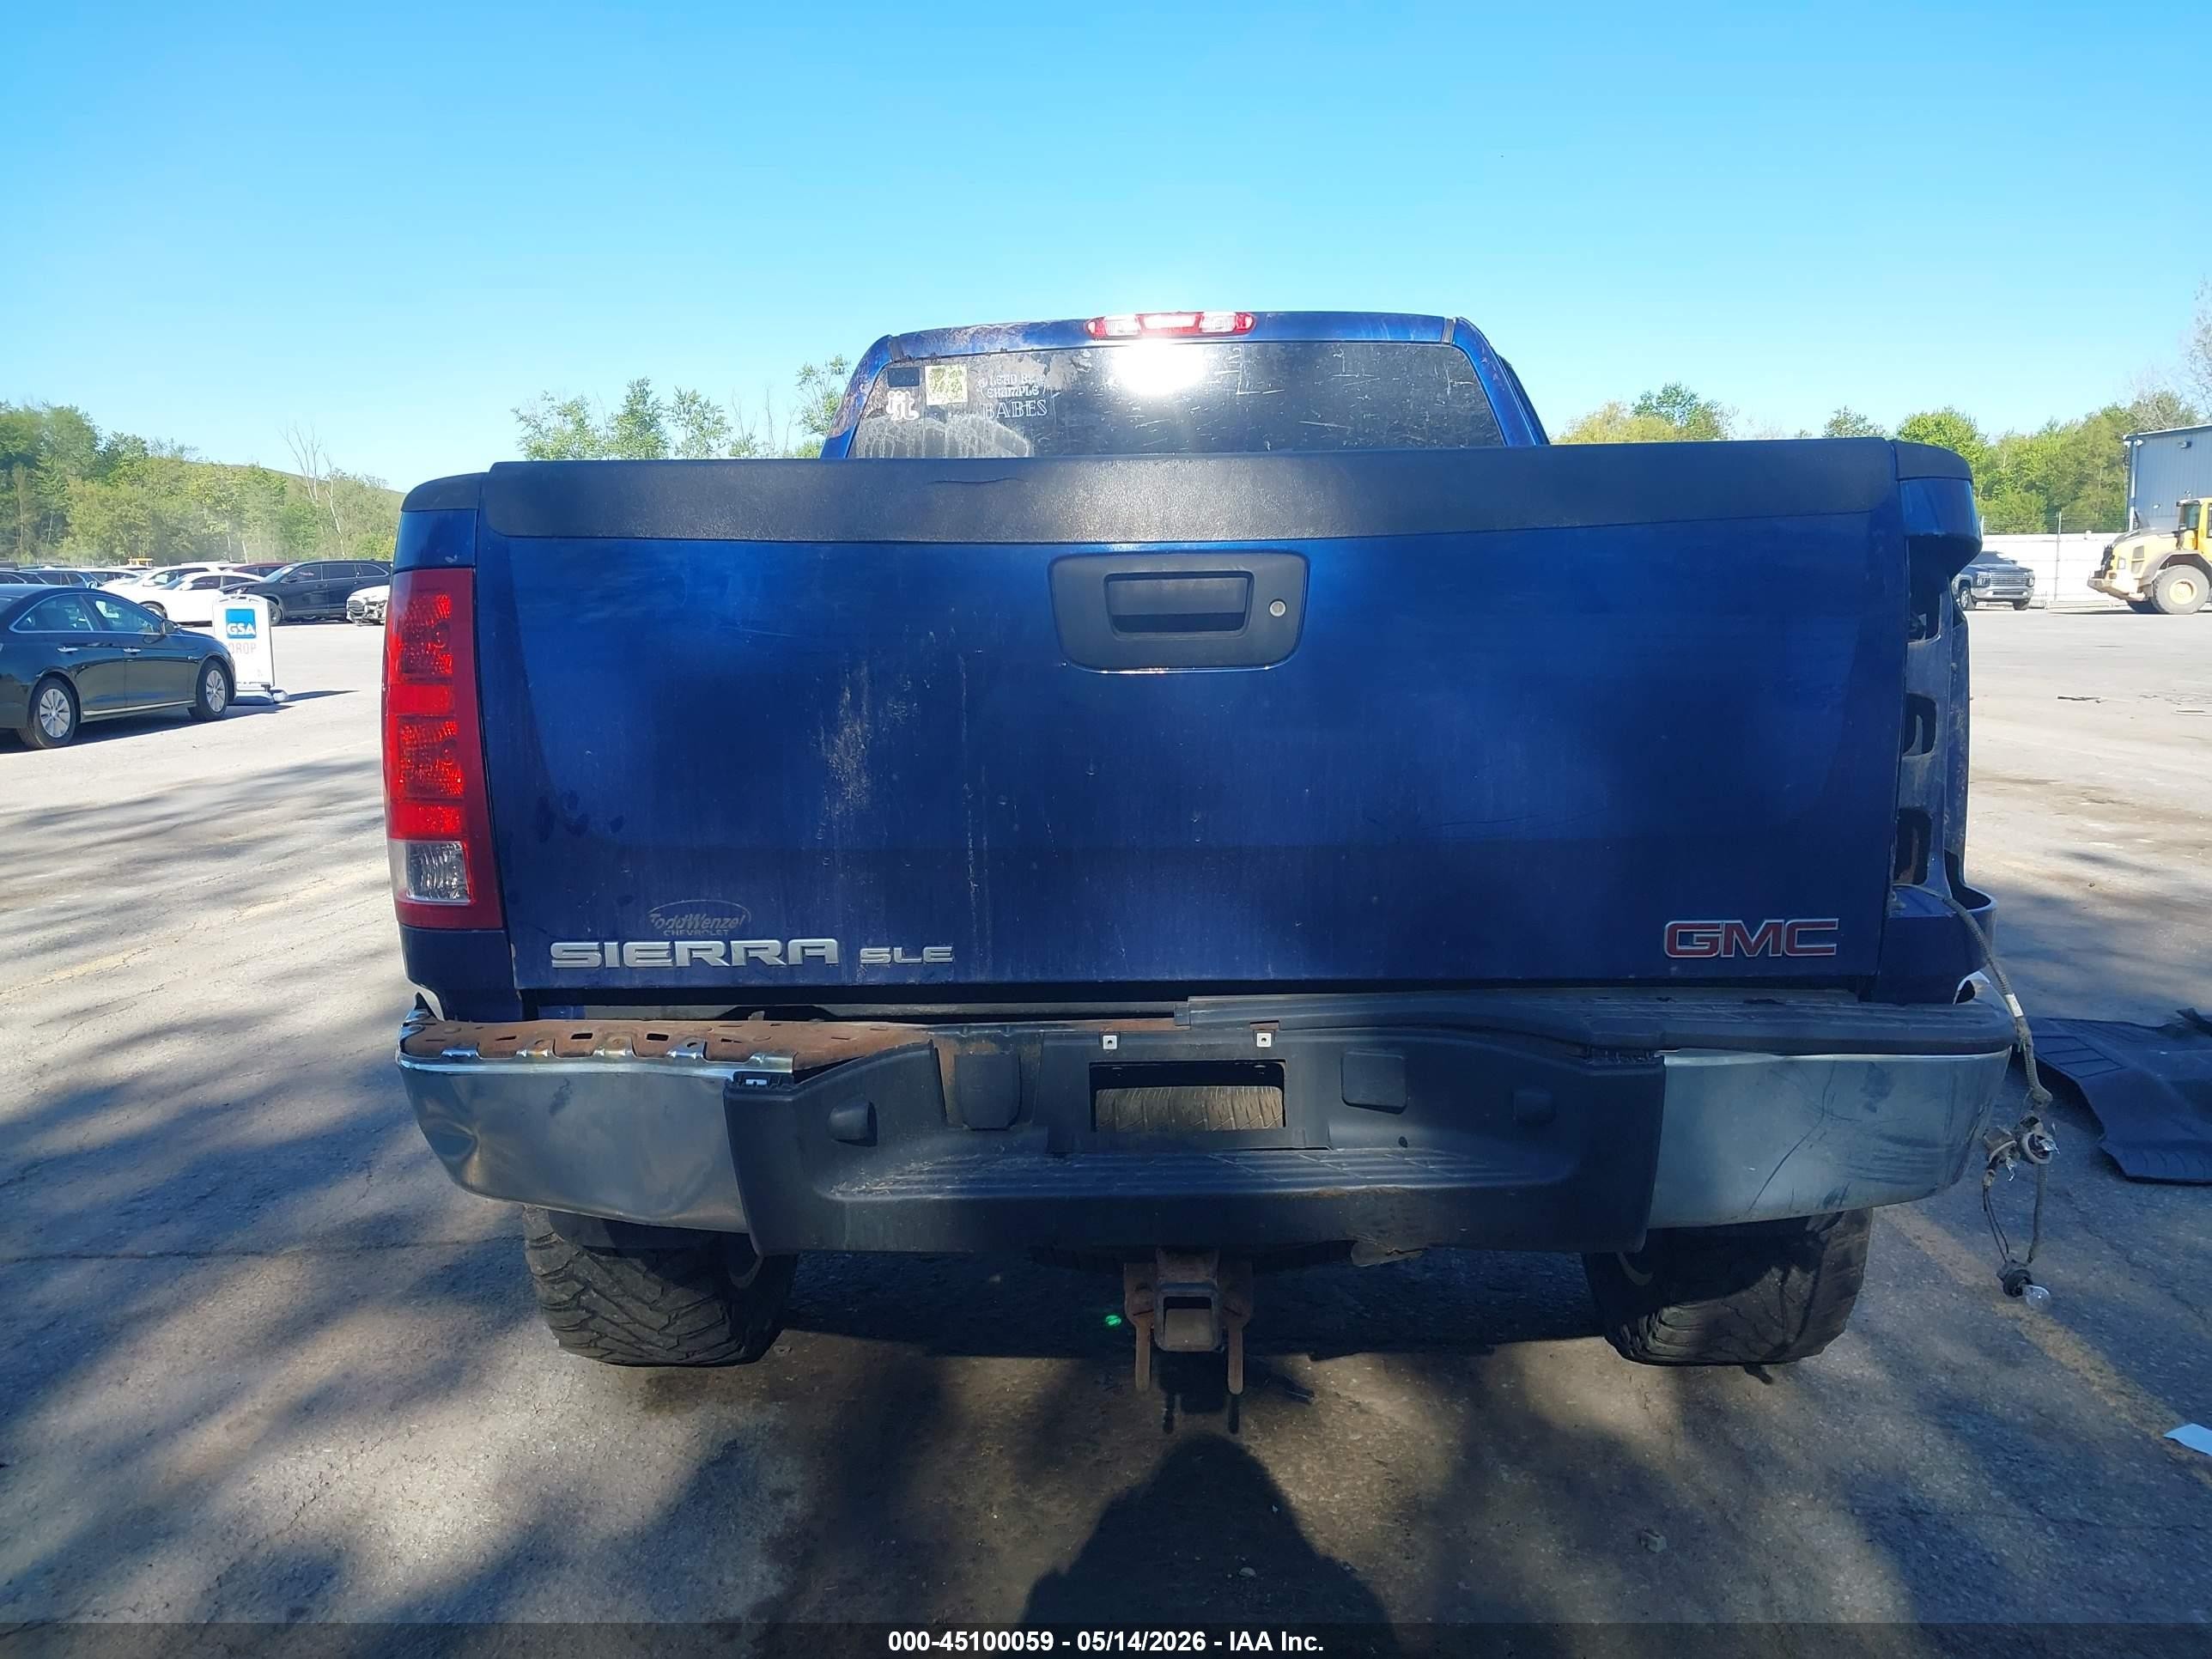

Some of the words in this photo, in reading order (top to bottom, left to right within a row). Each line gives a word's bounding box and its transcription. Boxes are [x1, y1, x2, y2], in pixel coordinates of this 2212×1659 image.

[981, 398, 1048, 420] BABES
[227, 622, 256, 635] GSA
[1663, 918, 1839, 958] GMC
[550, 938, 840, 969] SIERRA
[860, 945, 954, 965] SLE
